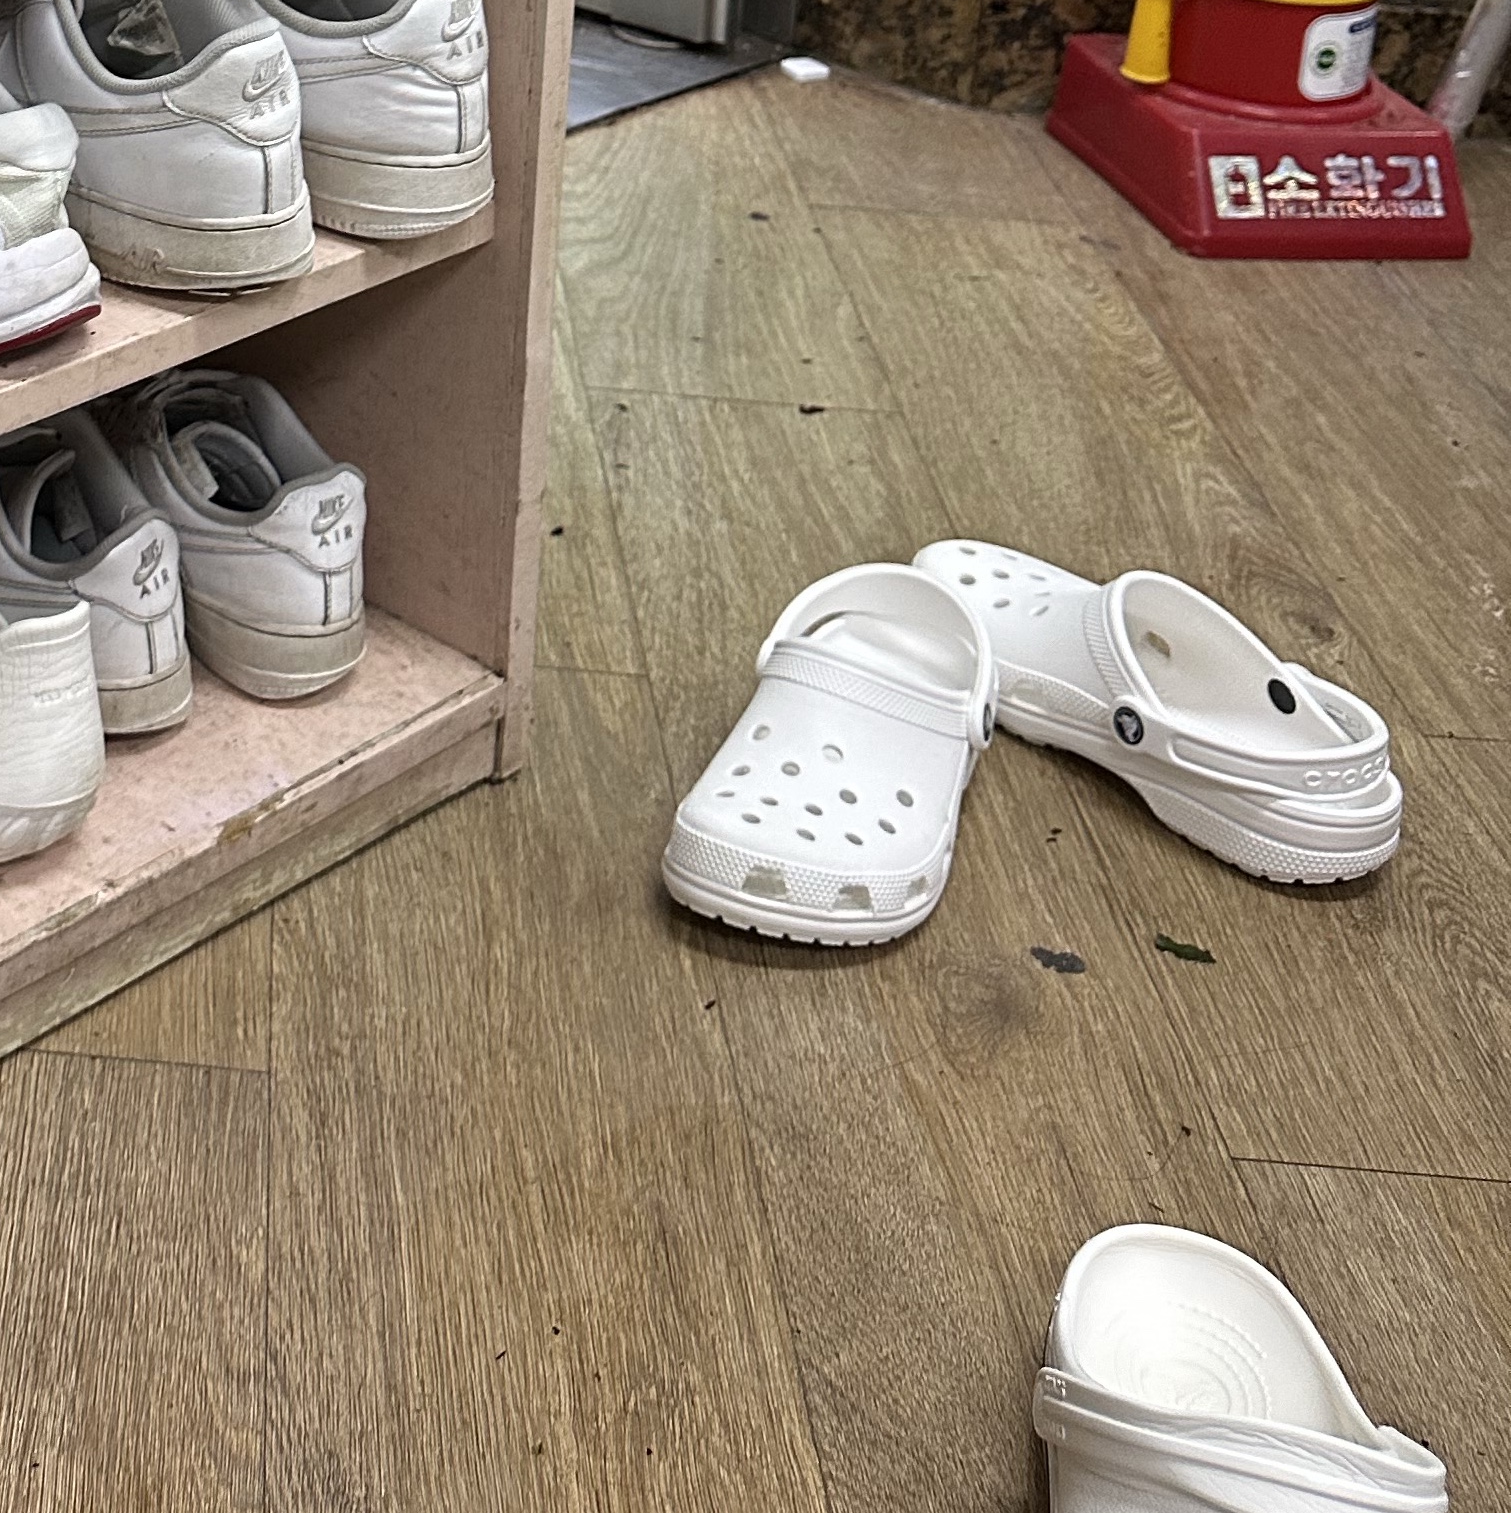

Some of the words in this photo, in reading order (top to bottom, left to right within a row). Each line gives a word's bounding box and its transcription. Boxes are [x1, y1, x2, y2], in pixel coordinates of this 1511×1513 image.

[446, 30, 485, 61] AIR
[249, 89, 291, 120] AIR
[1262, 153, 1443, 200] 소화기
[318, 524, 353, 549] AIR
[139, 567, 170, 599] AIR
